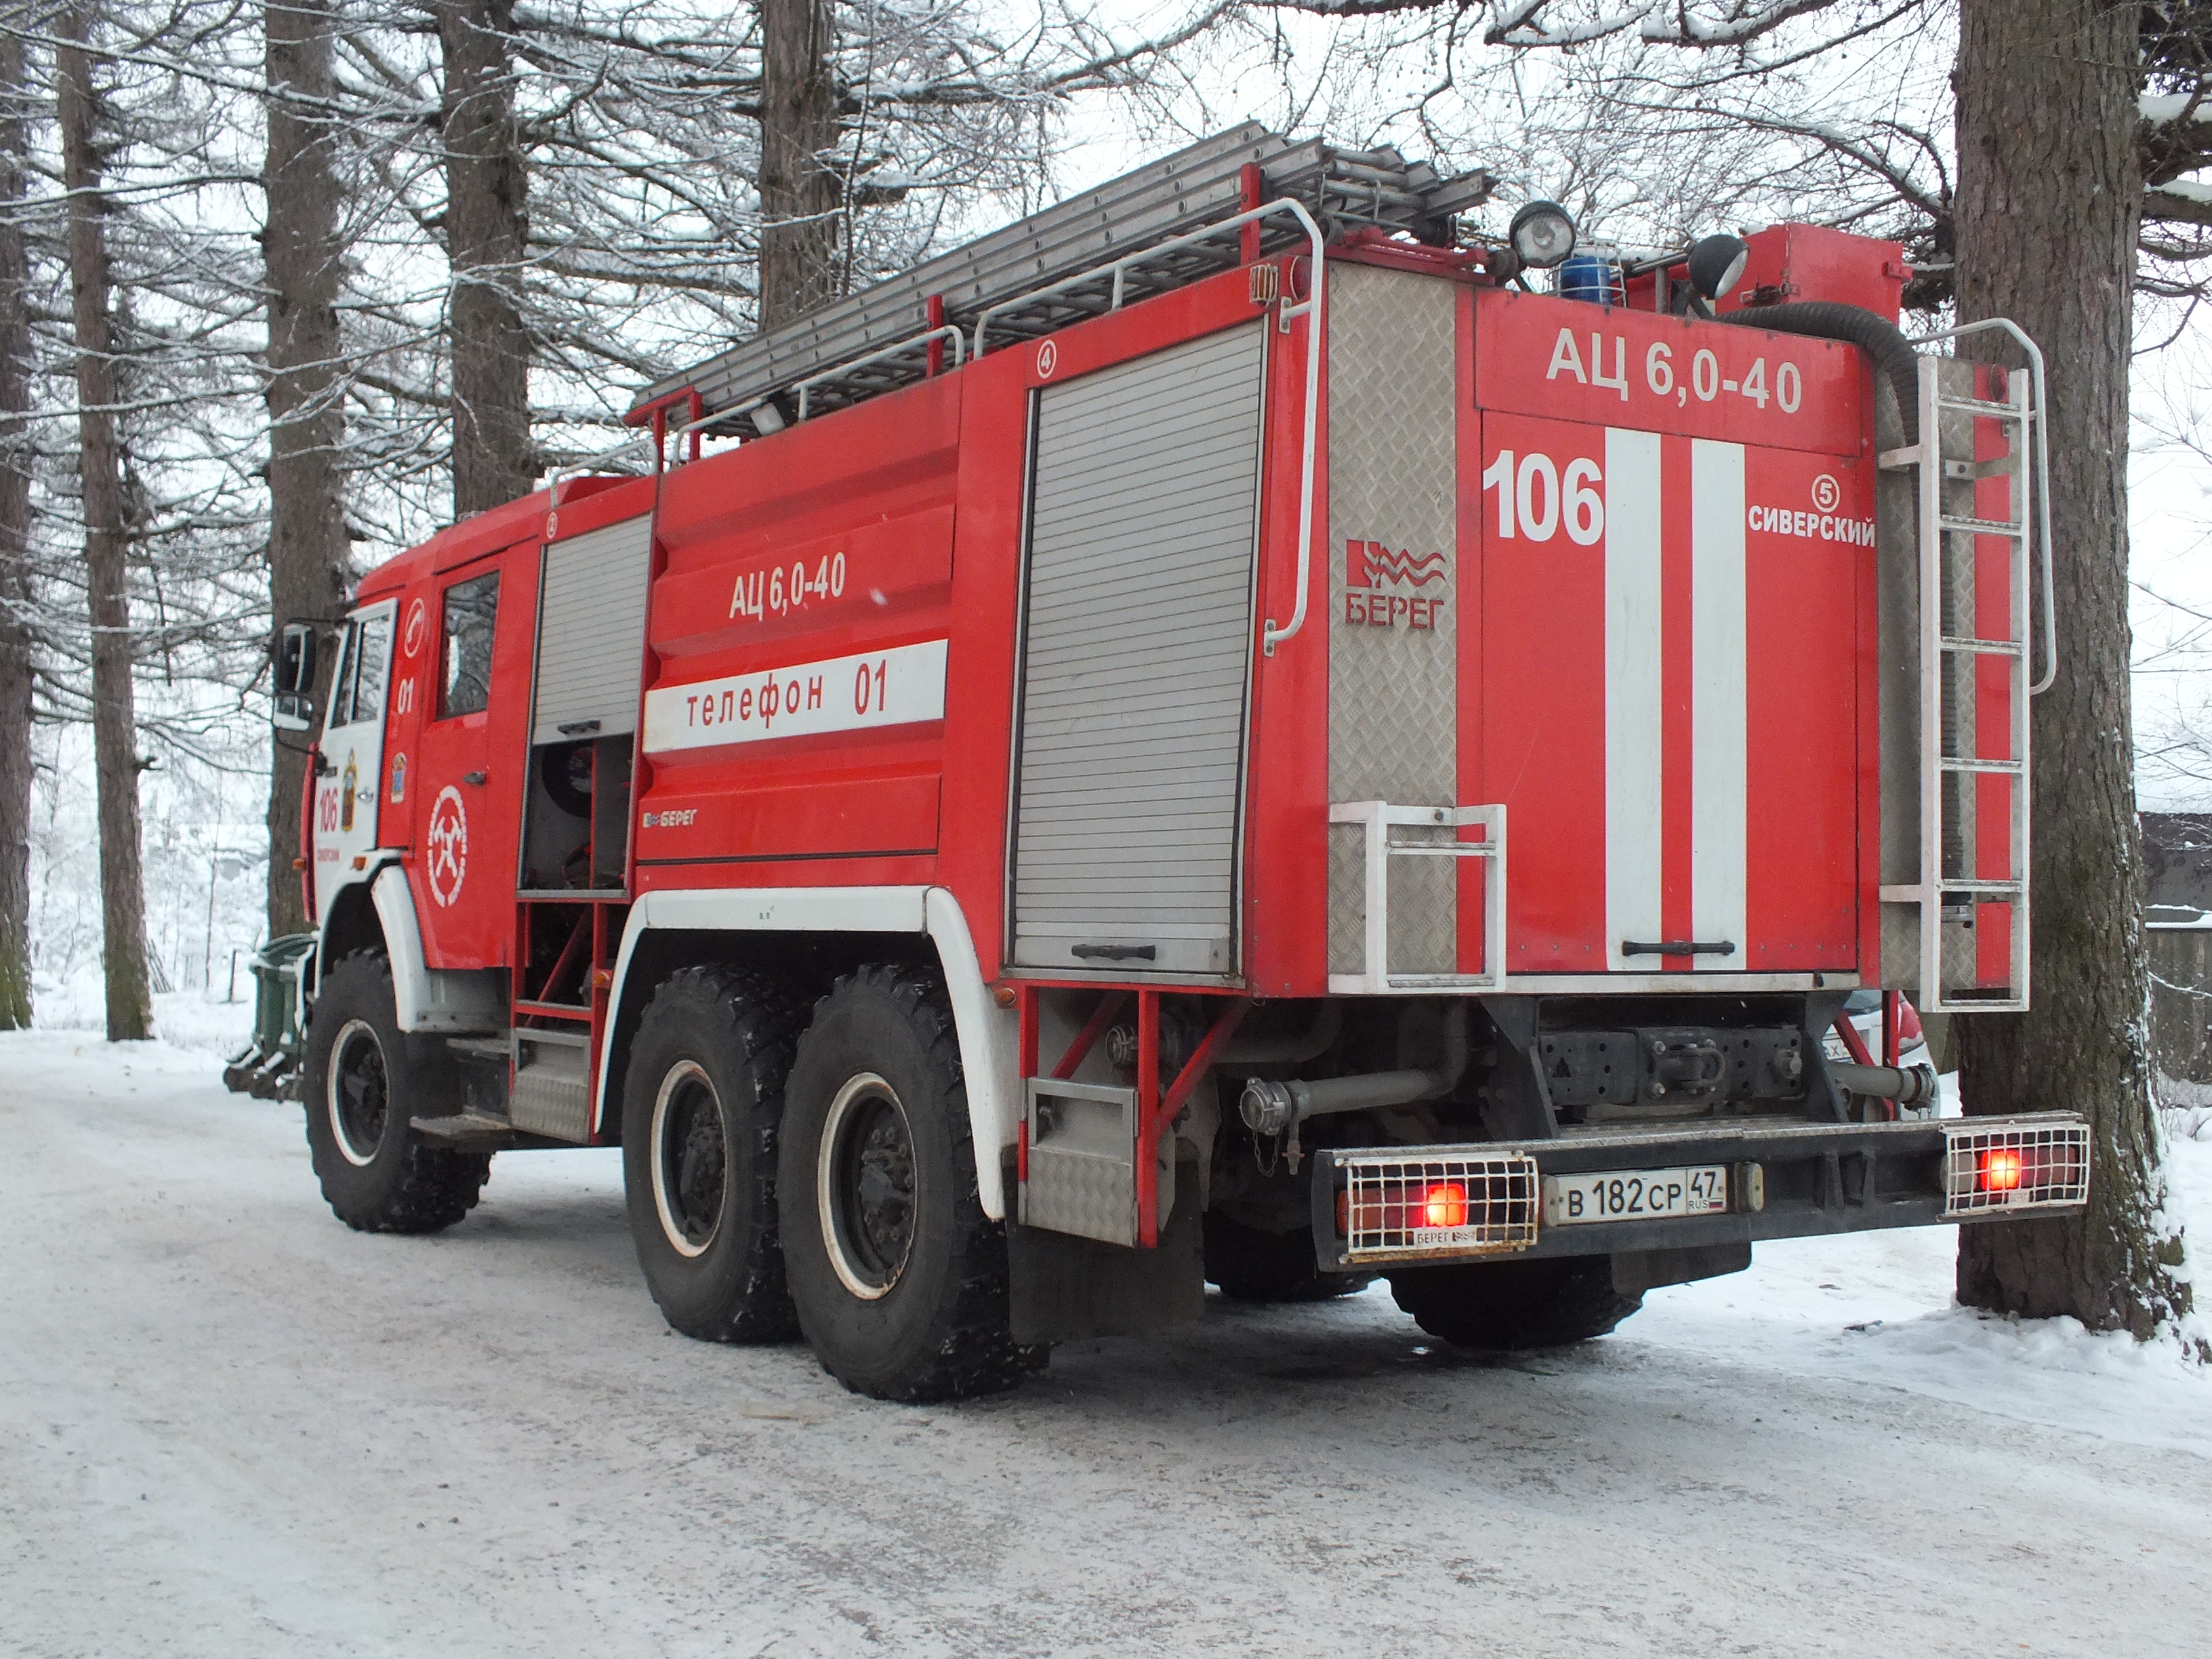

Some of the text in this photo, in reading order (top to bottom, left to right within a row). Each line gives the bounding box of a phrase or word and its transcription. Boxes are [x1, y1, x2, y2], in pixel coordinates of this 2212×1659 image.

[1545, 327, 1802, 414] АЦ 6,0-40
[1482, 449, 1605, 546] 106
[1818, 482, 1833, 505] 5
[1748, 504, 1876, 548] СИВЕРСКИЙ
[729, 552, 846, 622] АЦ 6,0-40
[1345, 592, 1445, 630] БЕРЕГ
[397, 676, 415, 716] 01
[687, 658, 887, 729] телефон 01
[321, 786, 338, 832] 106
[659, 808, 698, 827] БЕРЕГ
[1688, 1199, 1708, 1210] RUS
[1690, 1171, 1717, 1198] 47
[1416, 1231, 1449, 1244] БЕРЕГ
